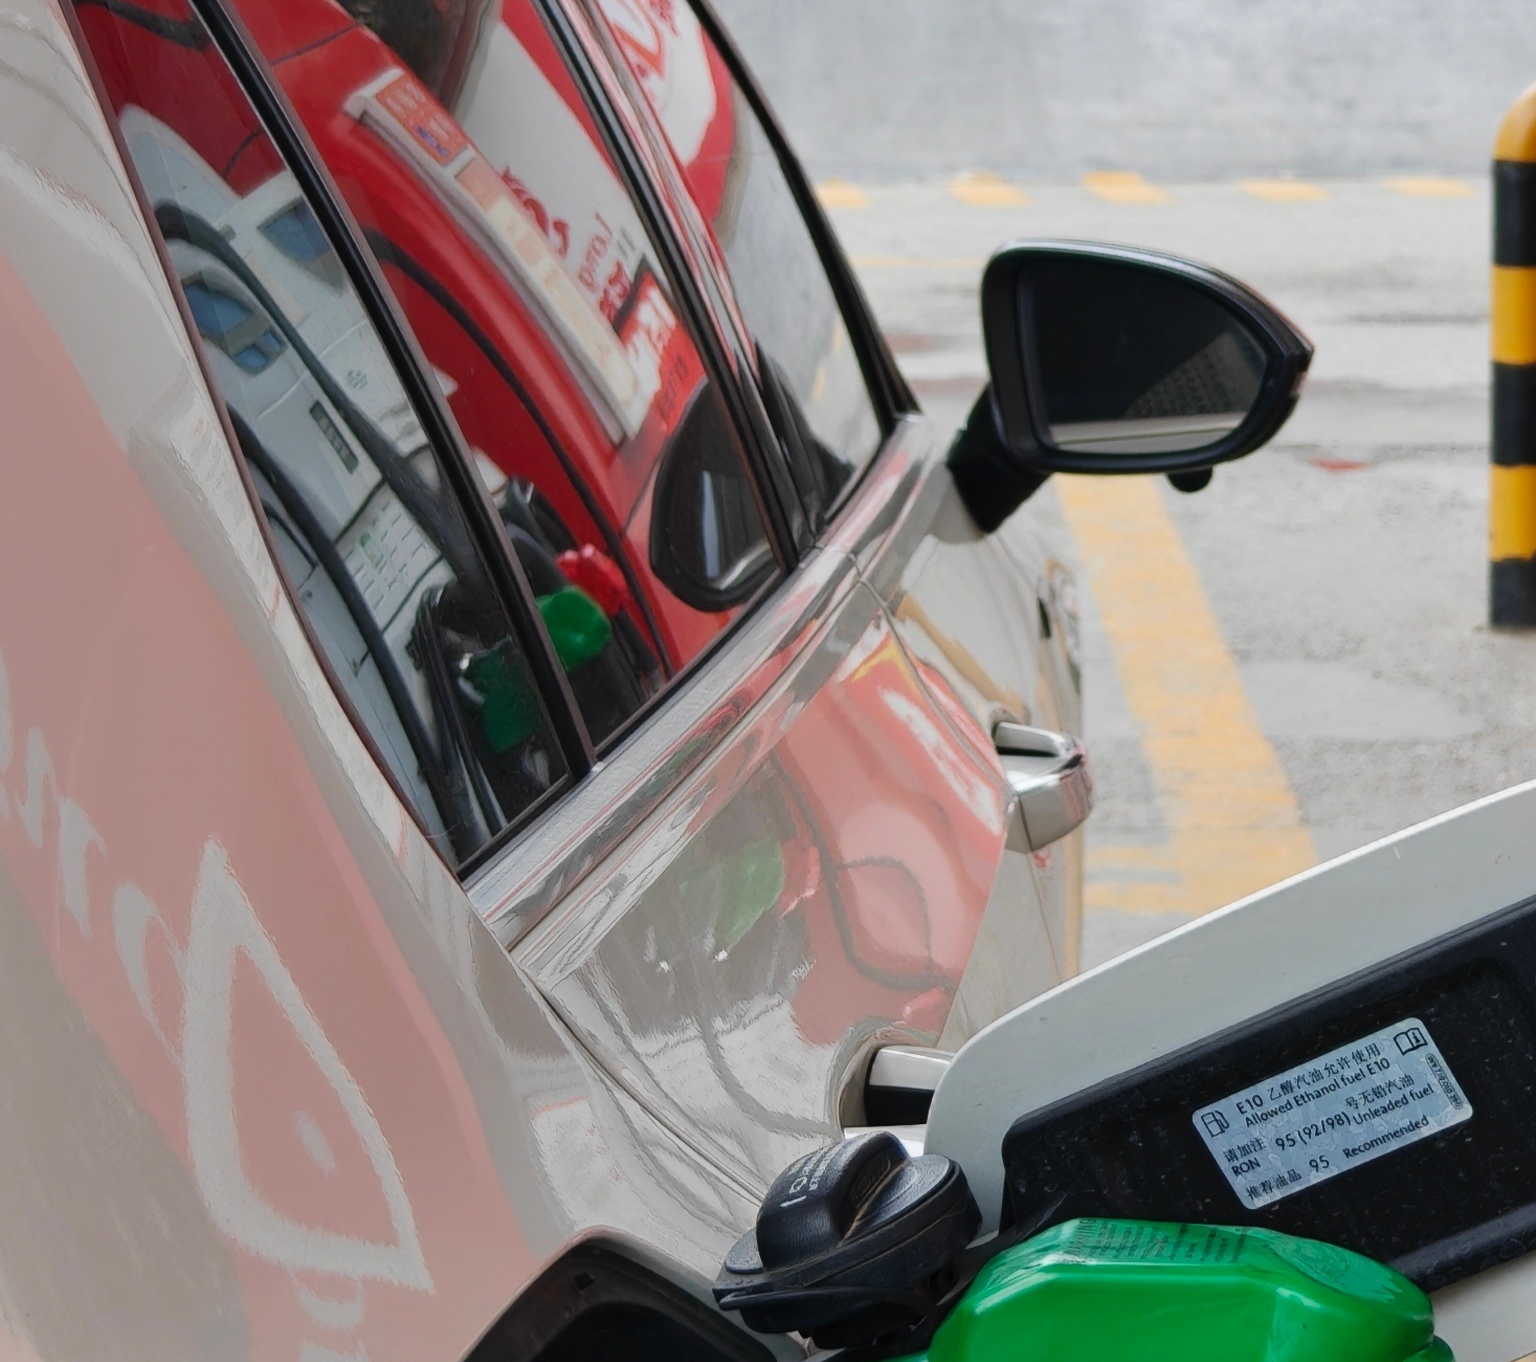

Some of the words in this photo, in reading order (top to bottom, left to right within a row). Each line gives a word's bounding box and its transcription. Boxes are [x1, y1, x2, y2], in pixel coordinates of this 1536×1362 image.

[1223, 1138, 1266, 1162] 请加注
[1345, 1073, 1415, 1109] 号无铅汽油
[1236, 1094, 1263, 1115] E10
[1267, 1042, 1381, 1101] 乙醇汽油允许使用
[1245, 1099, 1293, 1128] Allowed
[1294, 1079, 1340, 1107] Ethanol
[1340, 1068, 1366, 1087] fuel
[1366, 1057, 1390, 1075] E10
[1231, 1157, 1261, 1177] RON
[1353, 1094, 1409, 1124] Unleaded
[1409, 1082, 1435, 1100] fuel
[1246, 1169, 1302, 1199] 推荐油品
[1308, 1155, 1330, 1172] 95
[1342, 1114, 1430, 1158] Recommended
